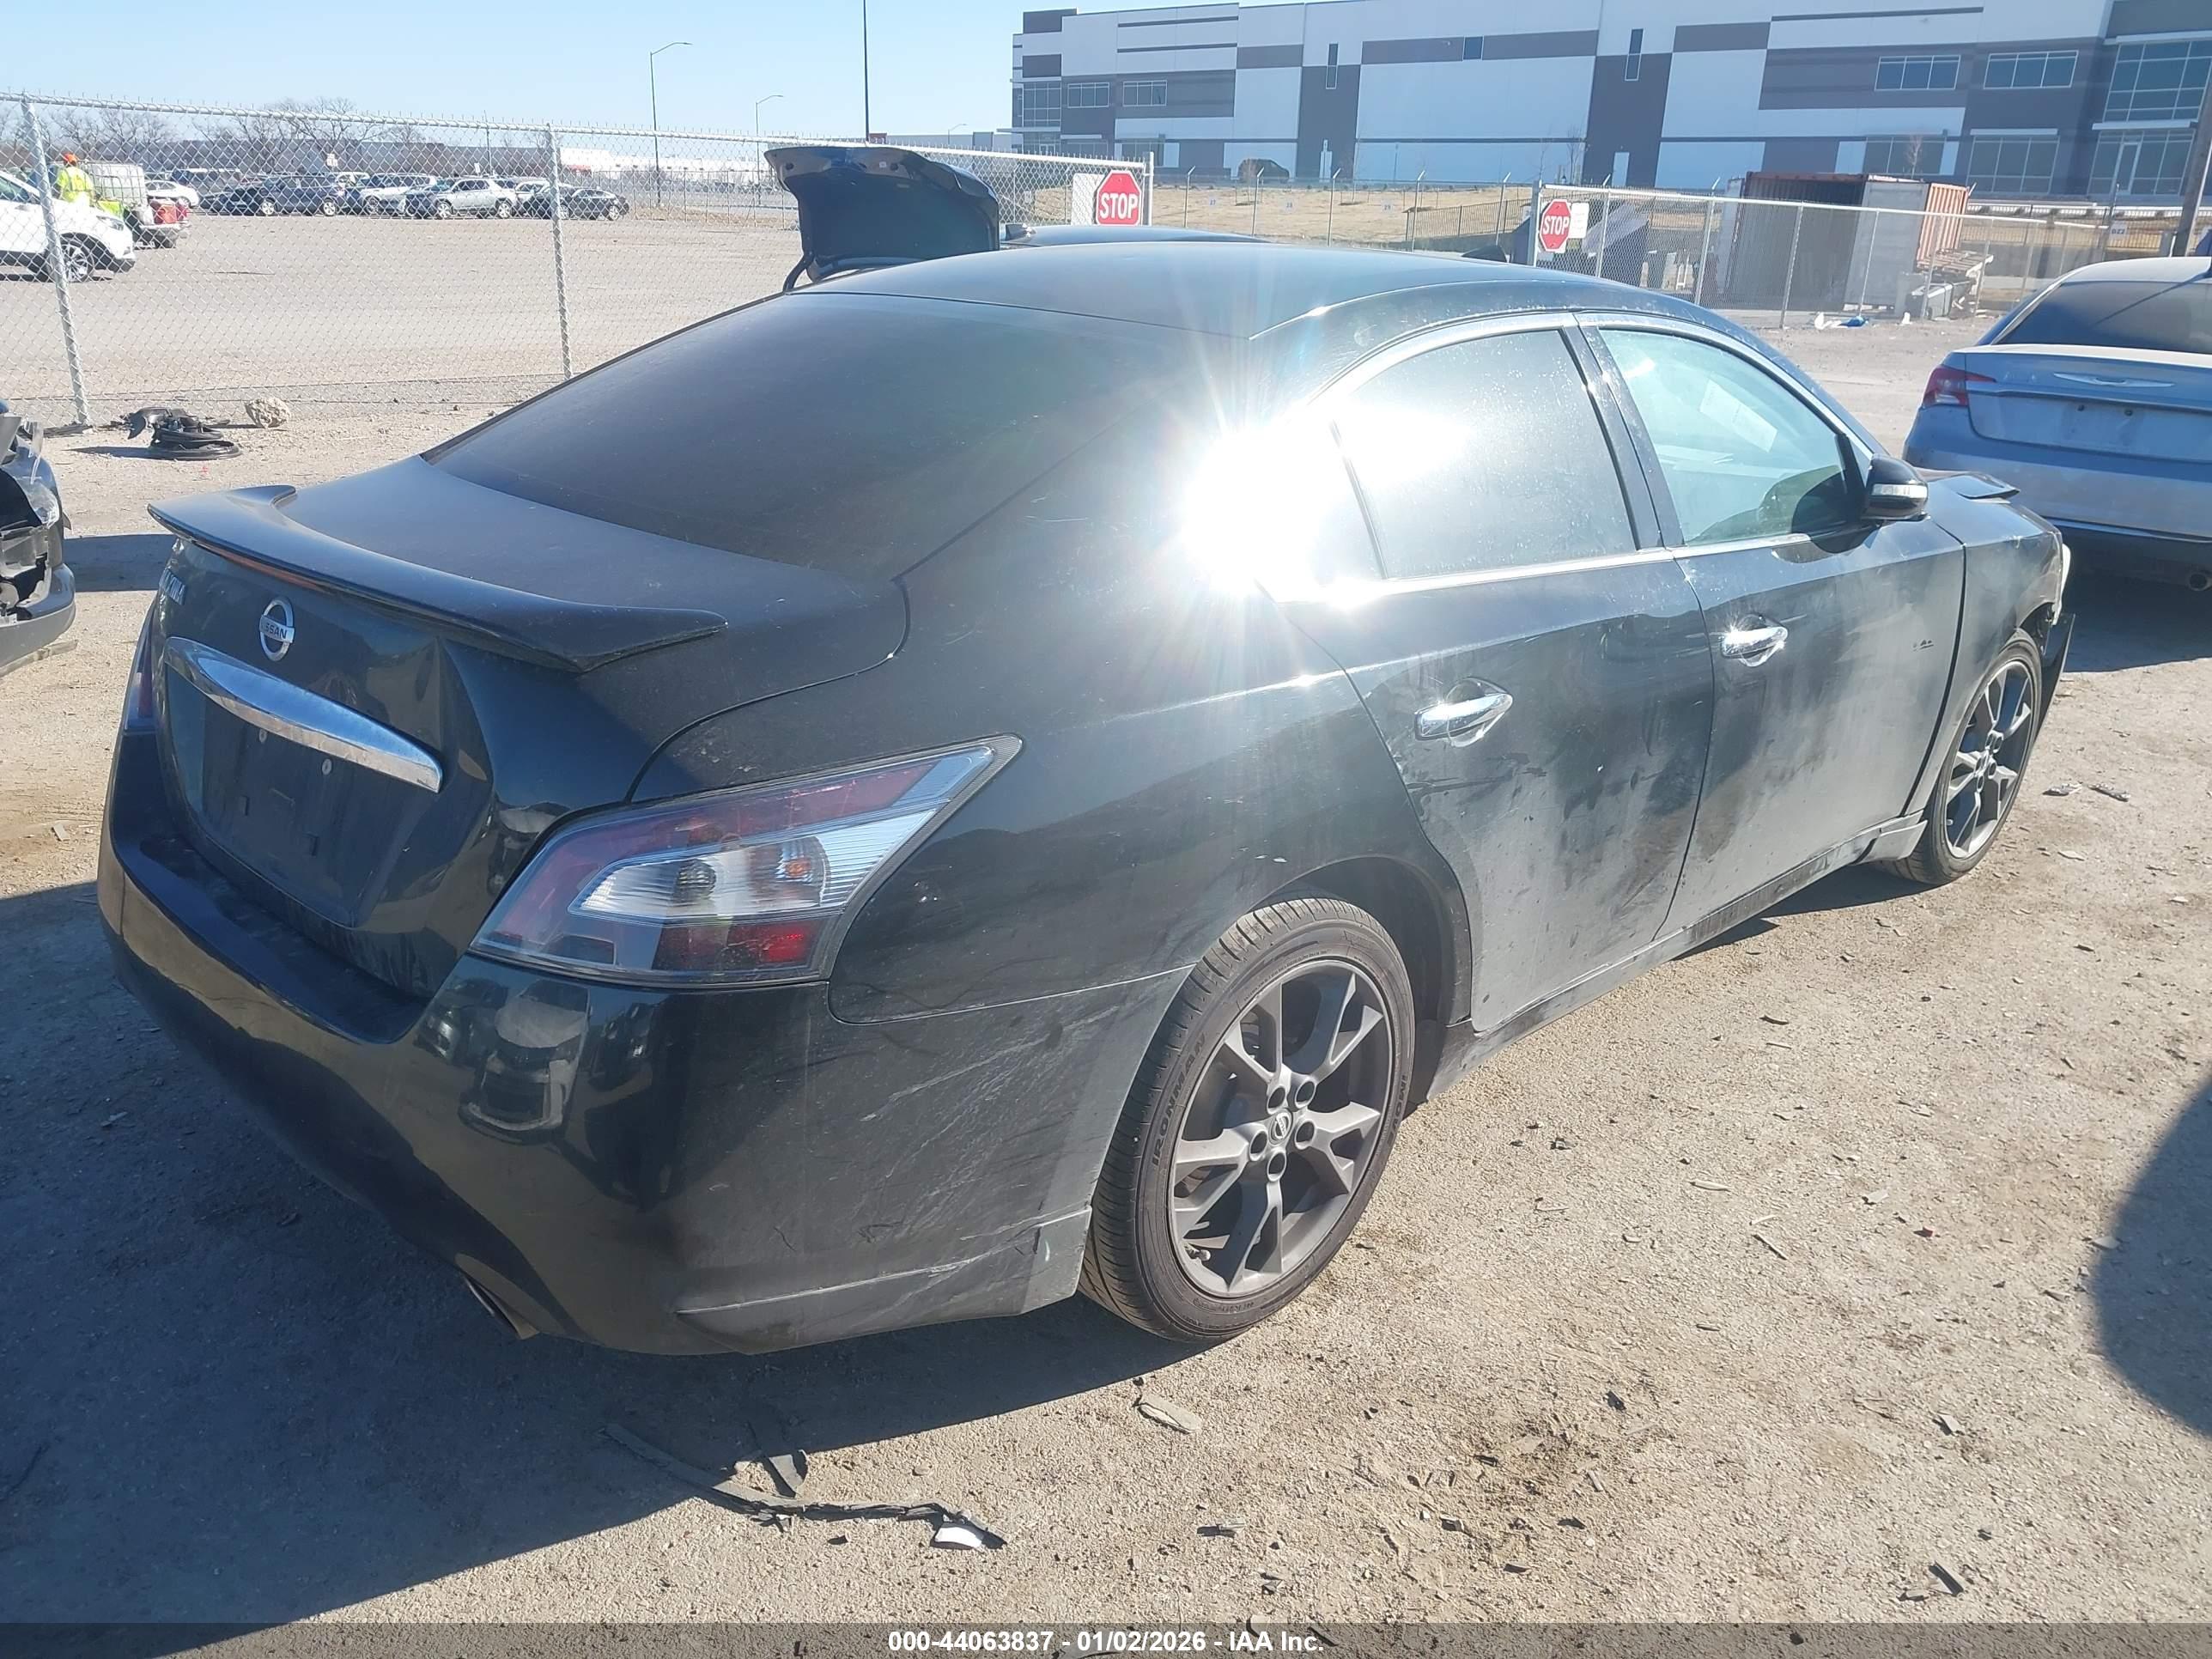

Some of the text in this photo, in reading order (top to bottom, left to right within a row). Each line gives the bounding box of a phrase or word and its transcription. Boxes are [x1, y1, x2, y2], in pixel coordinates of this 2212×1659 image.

[1099, 192, 1139, 220] STOP
[1541, 215, 1570, 235] STOP
[1152, 1031, 1206, 1166] IRONMAN
